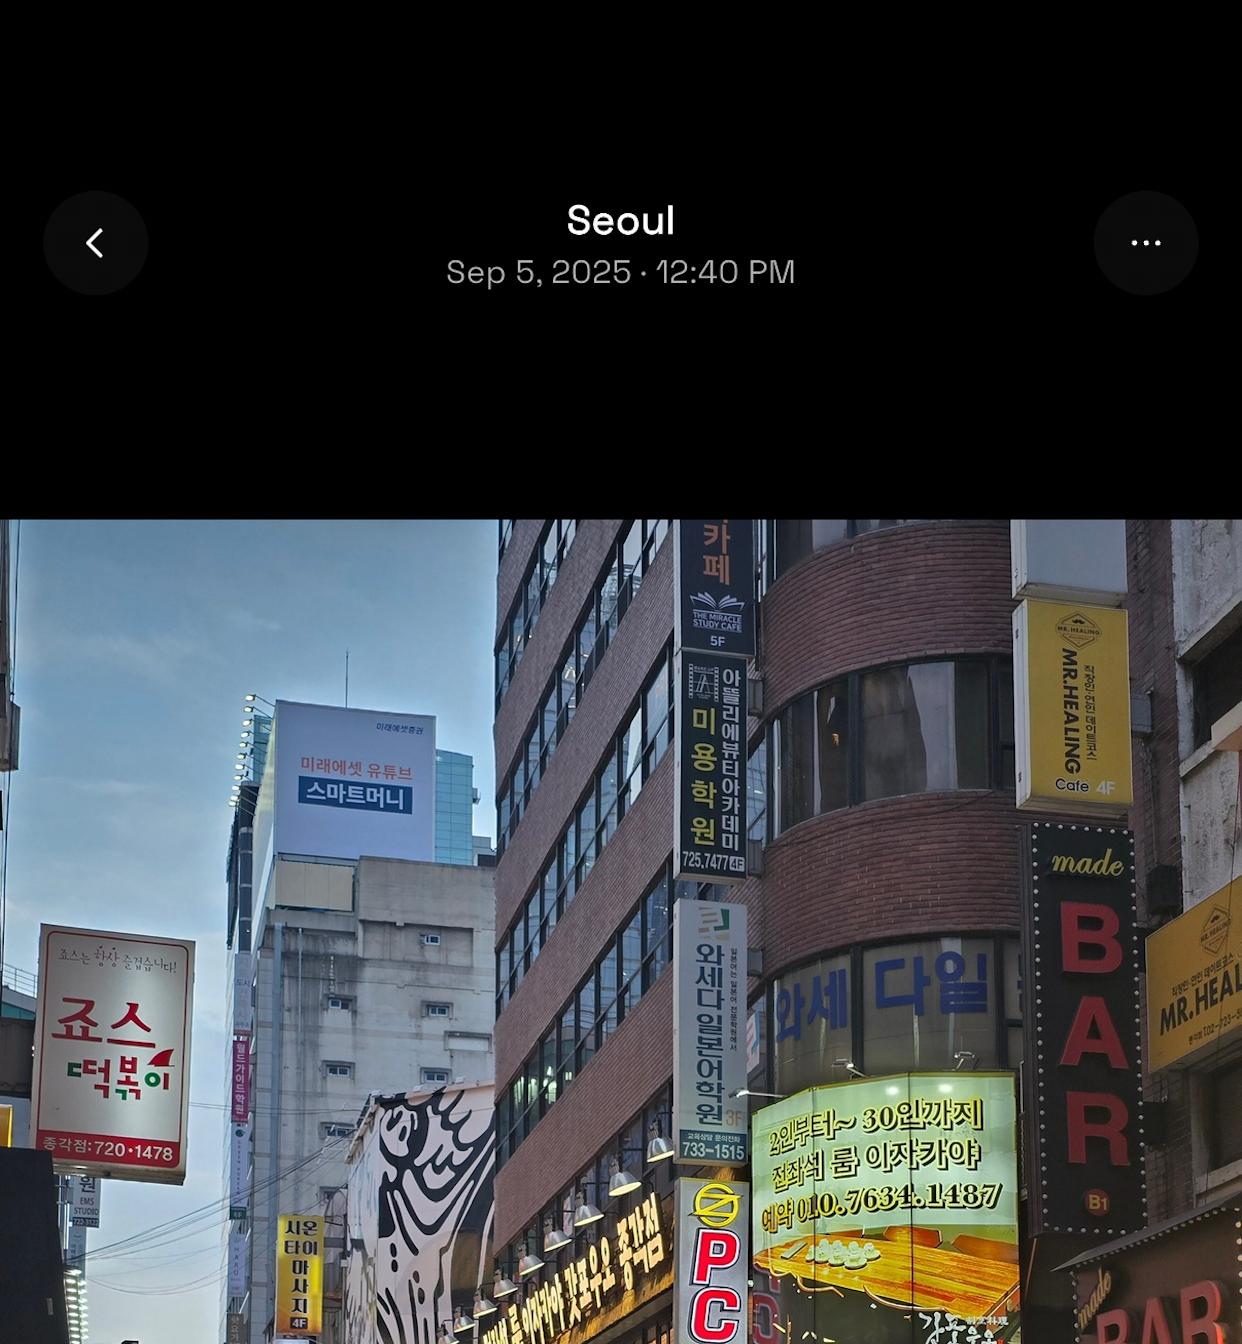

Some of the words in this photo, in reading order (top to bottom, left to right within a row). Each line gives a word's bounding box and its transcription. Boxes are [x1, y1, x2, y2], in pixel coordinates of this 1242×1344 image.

[693, 611, 708, 620] THE
[709, 613, 742, 624] MIRACLE
[693, 619, 720, 629] STUDY
[721, 621, 742, 631] CAFE
[710, 635, 725, 646] 5F
[1062, 648, 1081, 775] MR.HEALING
[1085, 715, 1097, 761] 데이트코스
[300, 756, 362, 777] 미래에셋
[367, 762, 413, 781] 유튜브
[721, 668, 741, 851] 아뜰리에뷰티아카데미
[690, 708, 717, 846] 미용학원
[1096, 780, 1115, 795] 4F
[306, 781, 404, 811] 스마트머니
[730, 856, 745, 871] 4F
[1050, 848, 1125, 877] made
[59, 948, 91, 966] 죠스는
[94, 945, 120, 967] 항상
[51, 997, 156, 1048] 죠스
[695, 943, 725, 1127] 와세다일본어학원
[1059, 900, 1131, 1166] BAR
[66, 1055, 170, 1101] 떡볶이
[725, 1109, 742, 1127] 3F
[862, 1098, 985, 1133] 30인까지
[682, 1141, 745, 1160] 733-1515
[771, 1148, 825, 1193] 전좌석
[830, 1144, 859, 1179] 룸
[865, 1138, 982, 1173] 이자카야
[73, 1207, 99, 1216] STUDIO
[80, 1197, 95, 1206] EMS
[761, 1196, 794, 1234] 예약
[797, 1182, 1003, 1222] 010.7634.1487
[1087, 1195, 1108, 1212] B1
[285, 1220, 318, 1236] 시온
[284, 1239, 318, 1256] 타이
[563, 1236, 616, 1328] 갓포우오
[616, 1192, 665, 1291] 종각점
[291, 1259, 309, 1314] 마사지
[688, 1228, 741, 1344] PC
[1077, 1266, 1112, 1330] made
[291, 1317, 307, 1329] 4F
